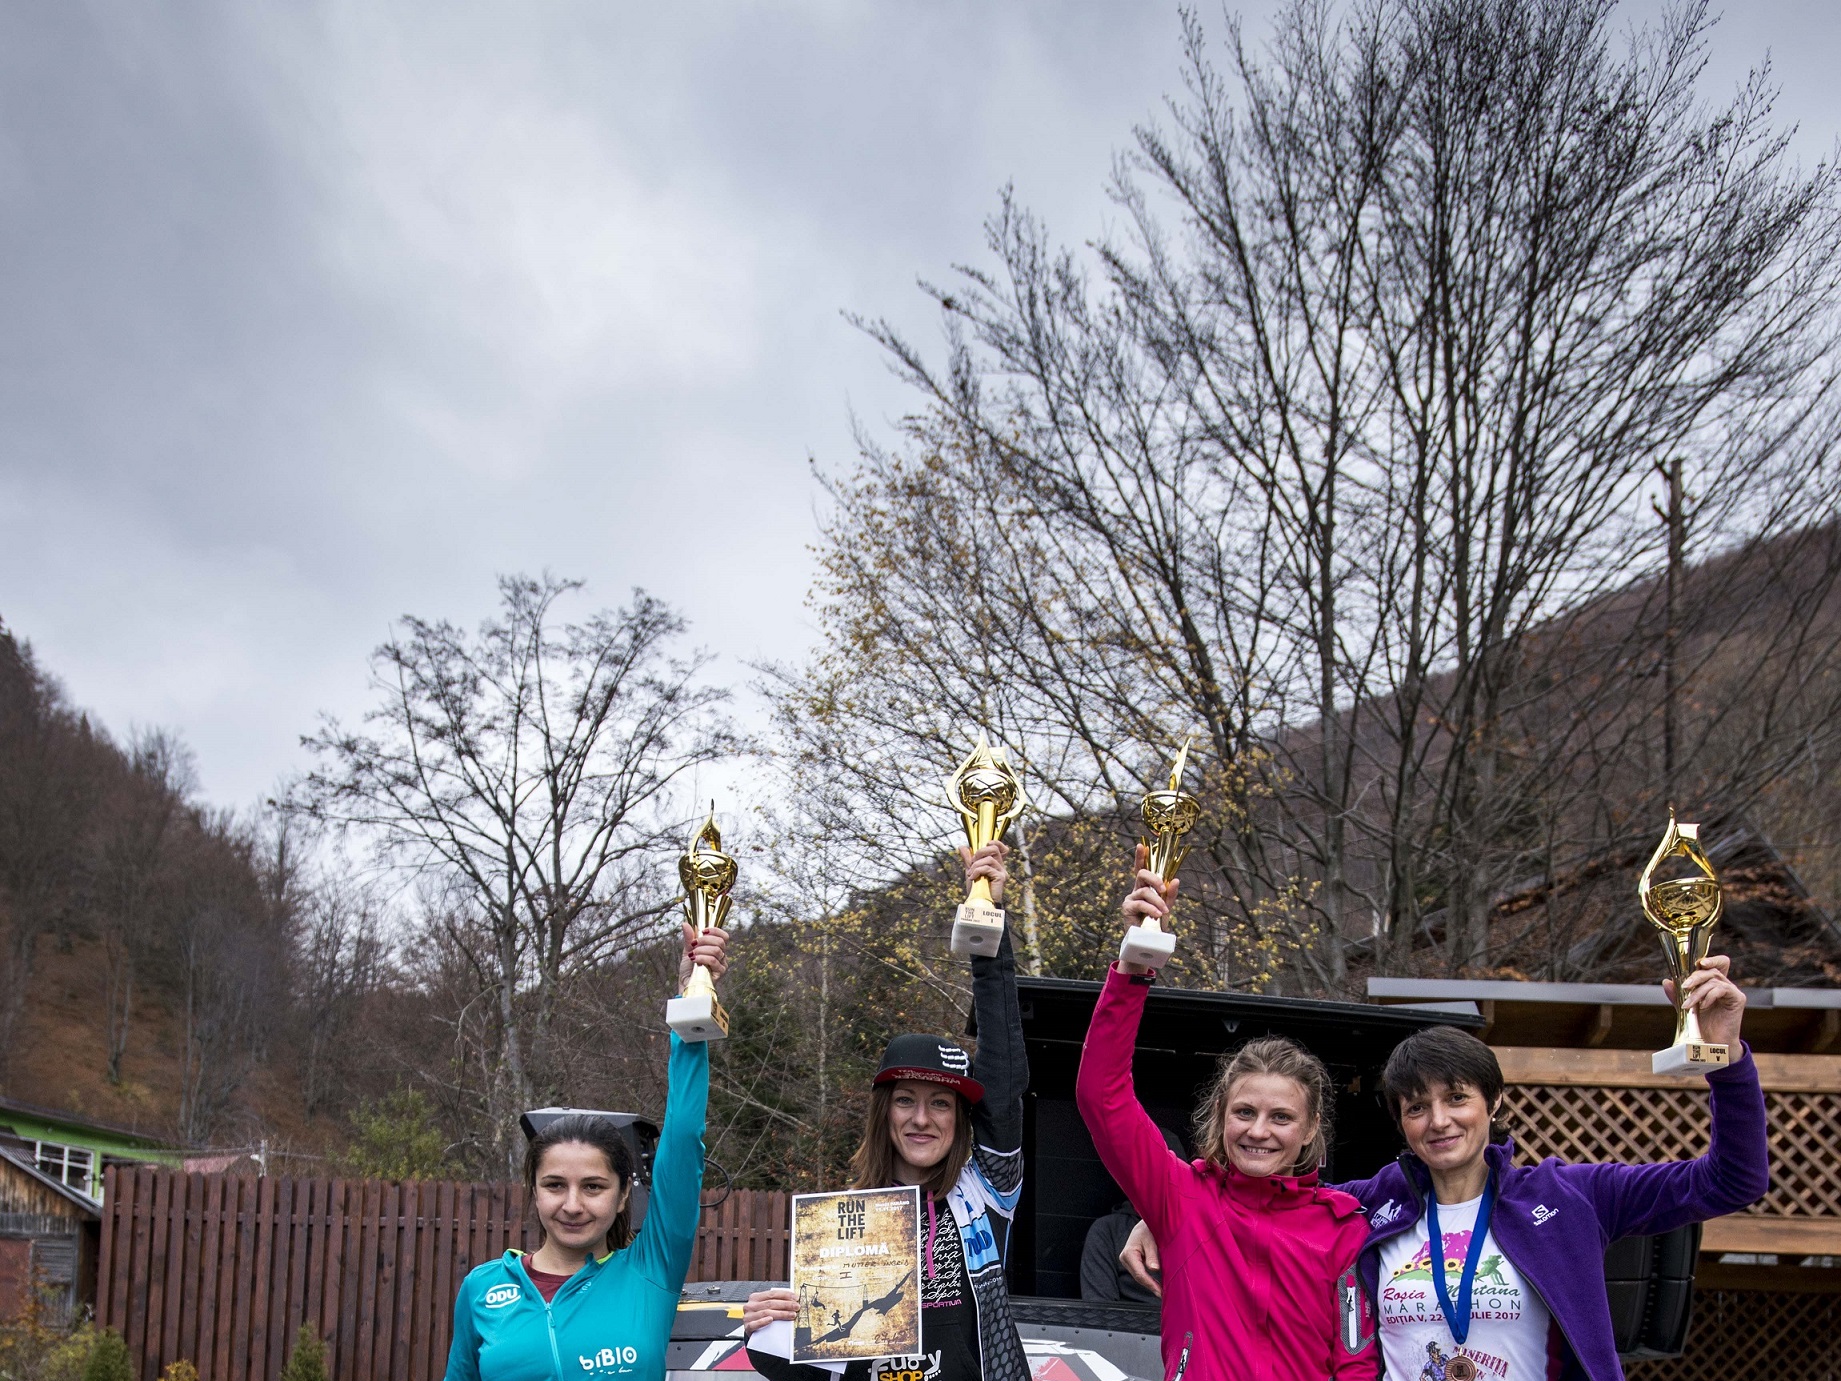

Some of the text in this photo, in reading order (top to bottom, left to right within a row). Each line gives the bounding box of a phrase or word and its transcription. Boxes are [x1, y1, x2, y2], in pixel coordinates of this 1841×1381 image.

[838, 1200, 866, 1214] RUN
[838, 1214, 866, 1227] THE
[838, 1226, 866, 1240] LIFT
[485, 1287, 519, 1304] ODU
[1446, 1284, 1521, 1298] Mntana
[1384, 1298, 1521, 1315] MARATHON
[1470, 1312, 1492, 1320] ULIE
[1496, 1312, 1521, 1320] 2017
